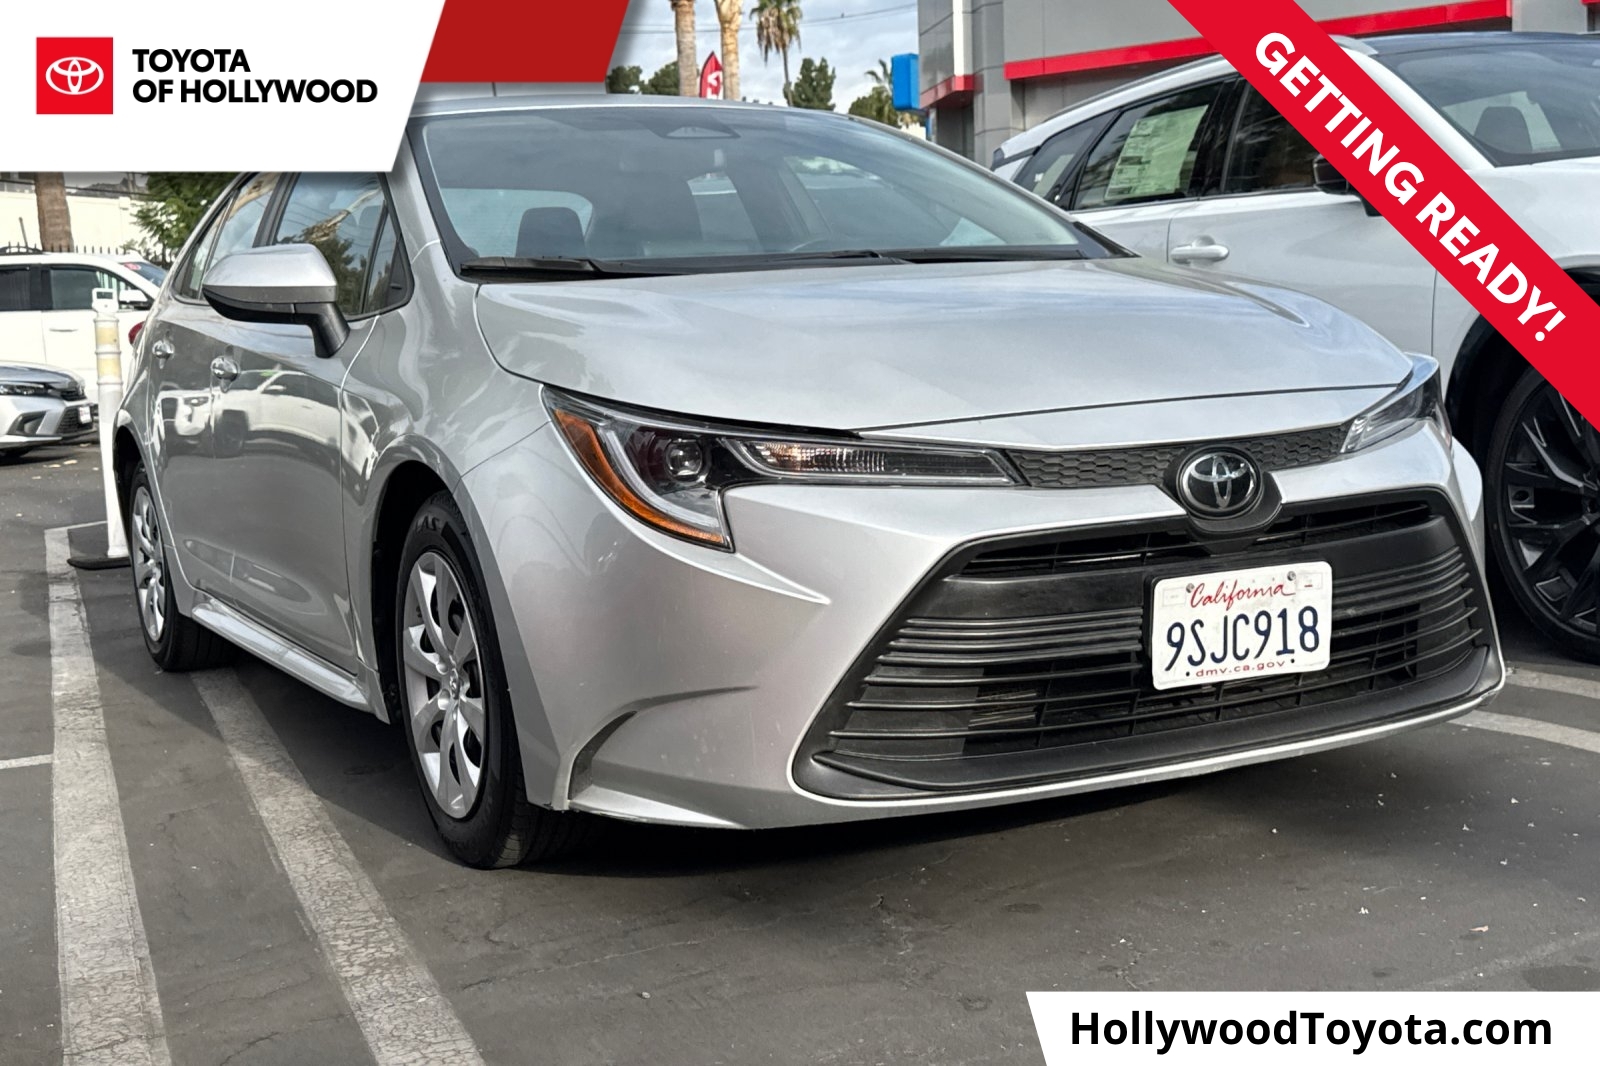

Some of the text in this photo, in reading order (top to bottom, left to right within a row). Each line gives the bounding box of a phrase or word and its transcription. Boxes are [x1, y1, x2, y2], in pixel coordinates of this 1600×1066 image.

[1190, 579, 1296, 611] California
[1165, 605, 1320, 672] 9SJC918
[1195, 659, 1286, 678] dmv.ca.gov
